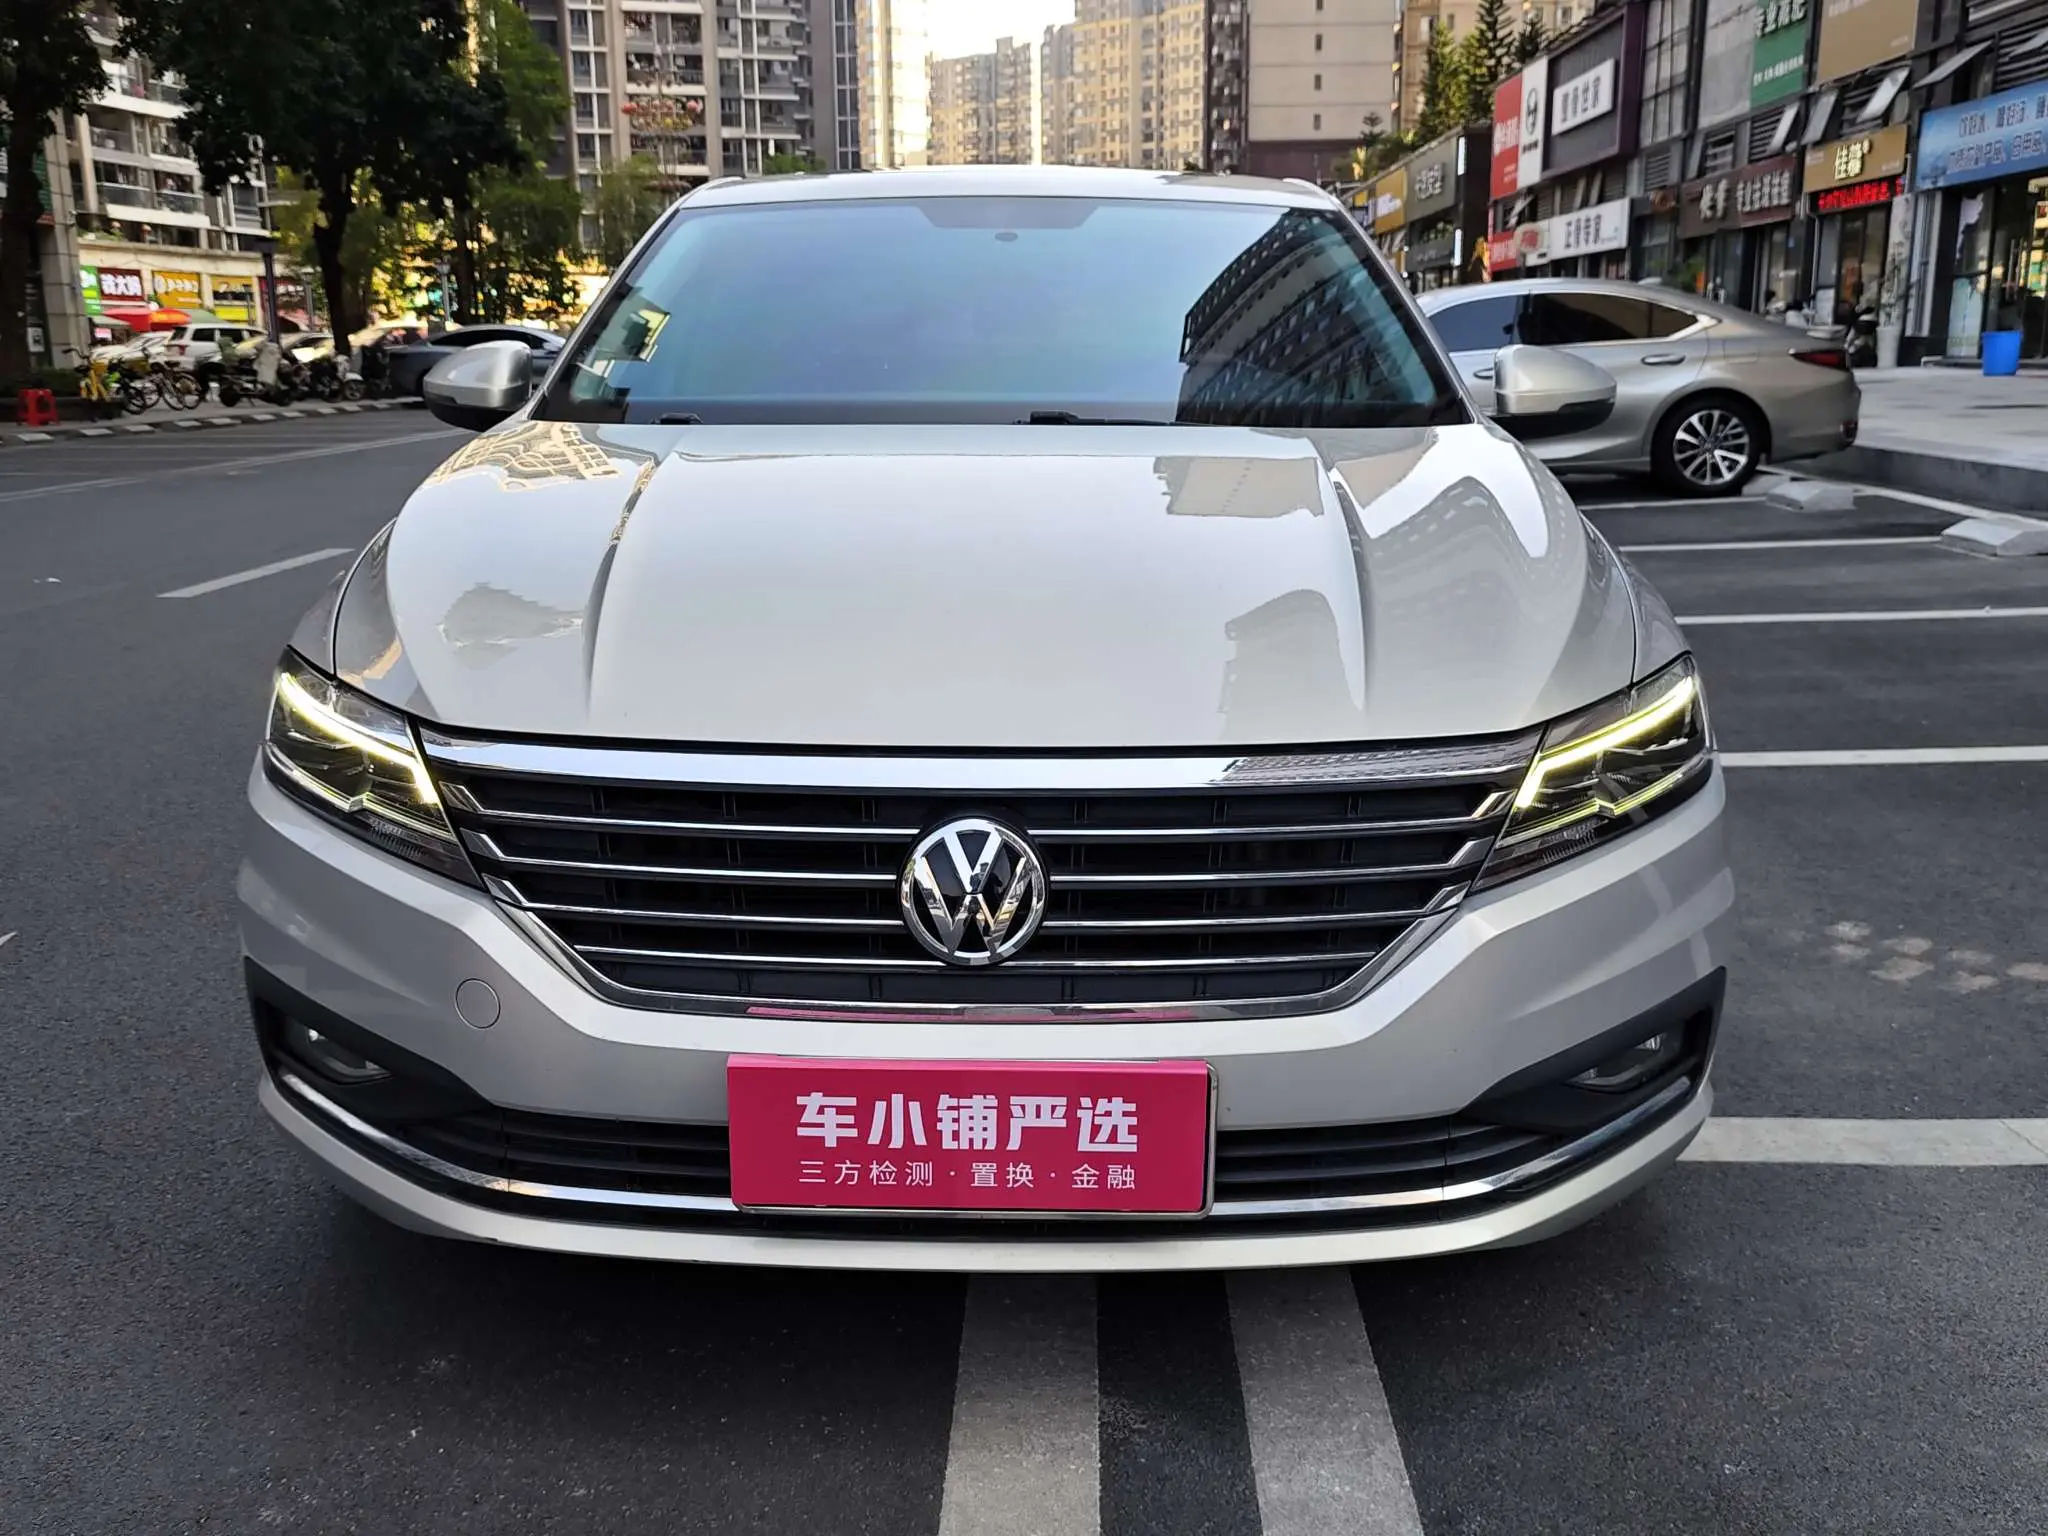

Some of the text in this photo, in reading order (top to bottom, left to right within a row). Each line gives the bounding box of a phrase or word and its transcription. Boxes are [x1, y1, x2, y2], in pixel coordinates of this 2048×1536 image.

[903, 820, 1044, 964] VW
[796, 1092, 1138, 1152] 车小铺严选
